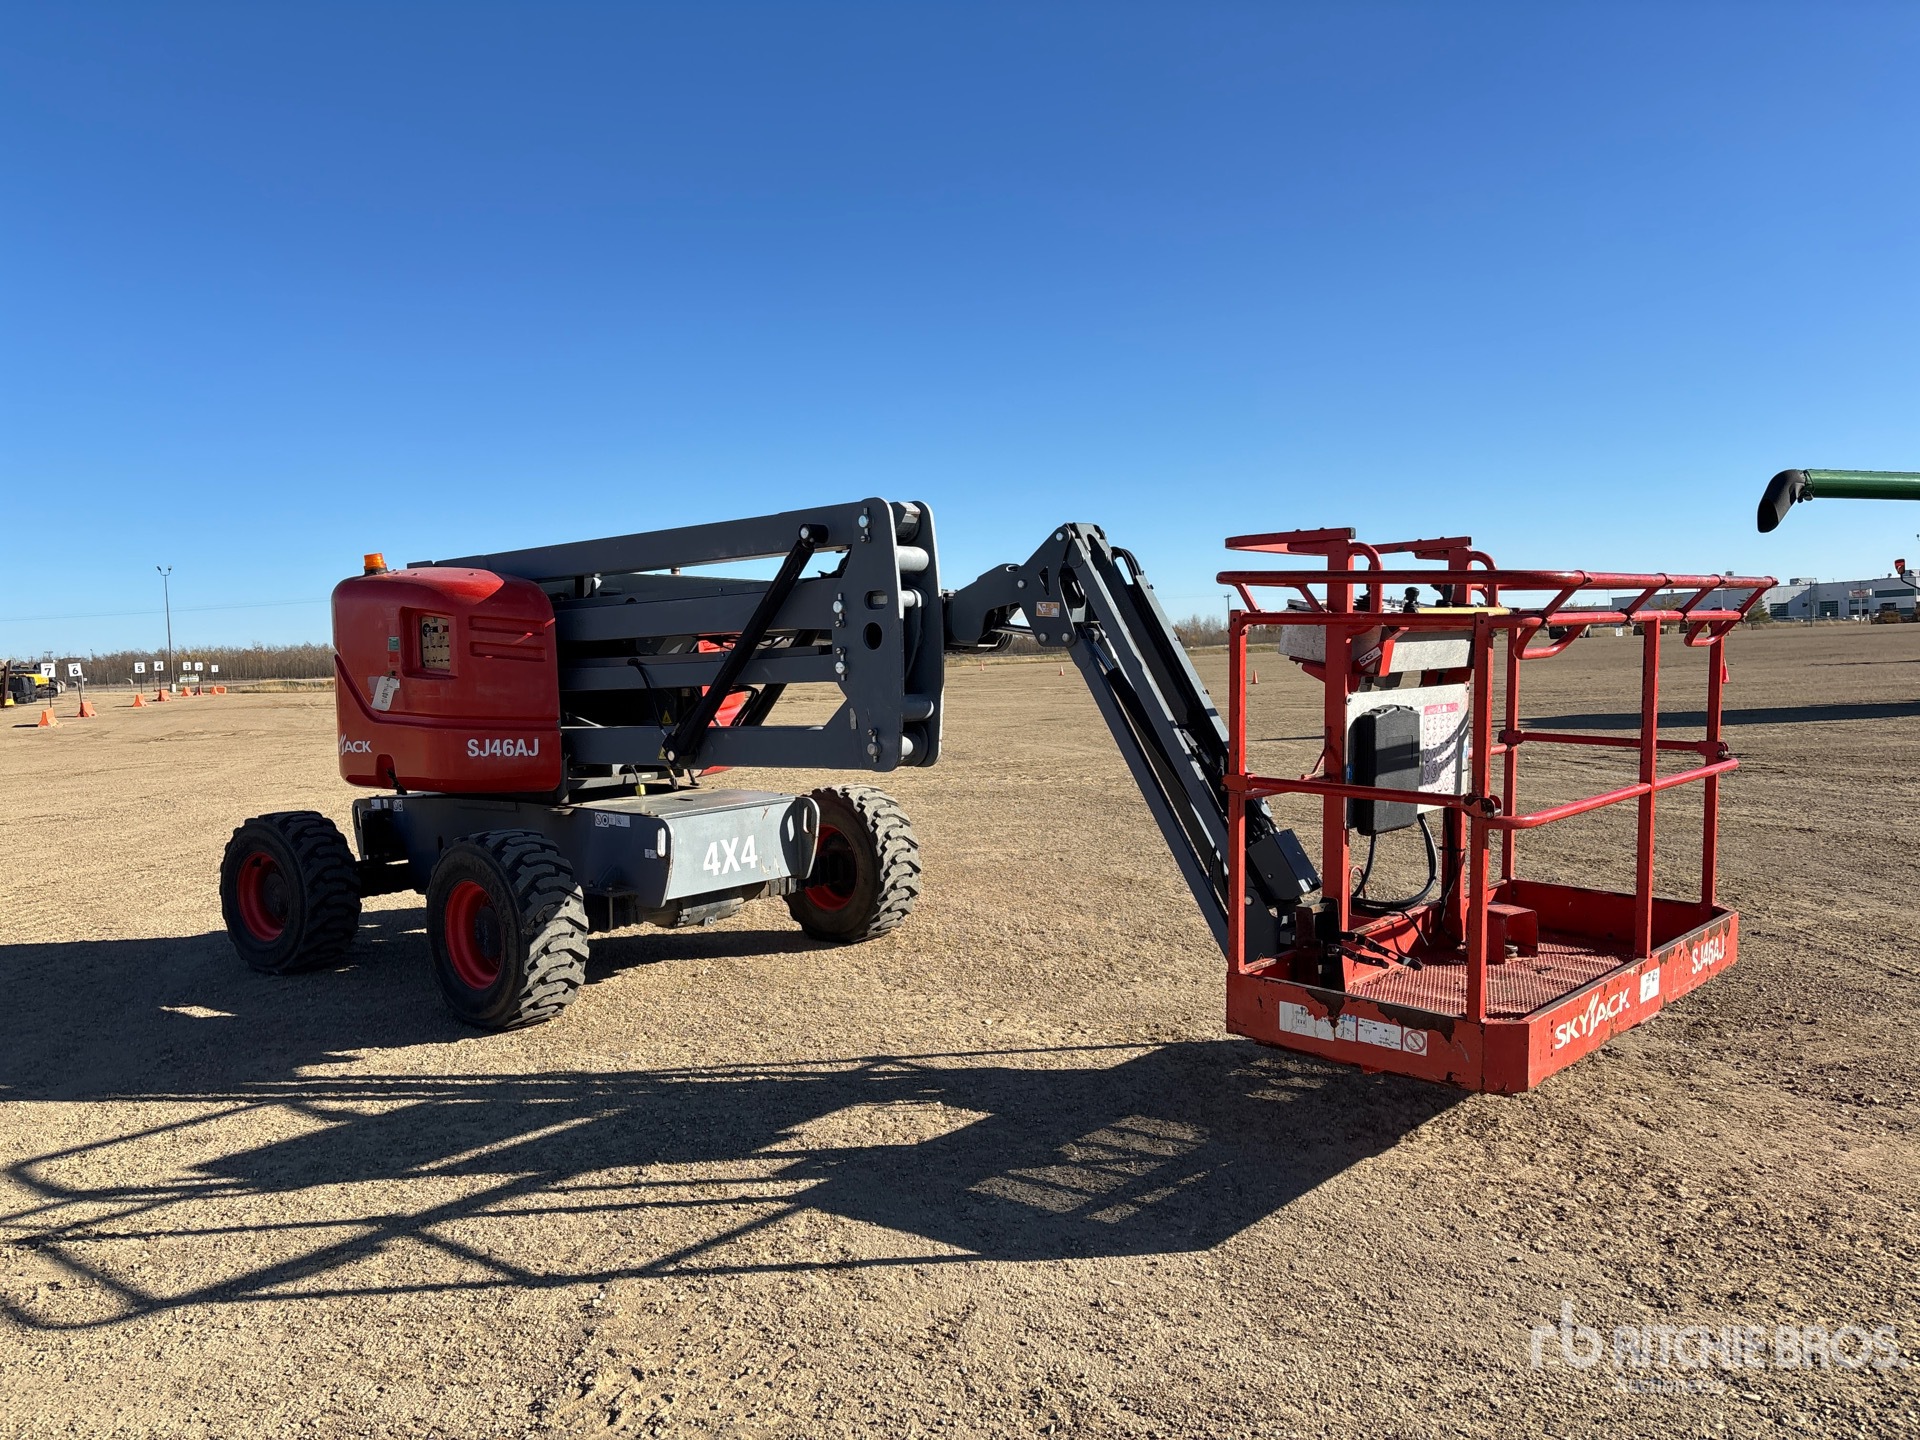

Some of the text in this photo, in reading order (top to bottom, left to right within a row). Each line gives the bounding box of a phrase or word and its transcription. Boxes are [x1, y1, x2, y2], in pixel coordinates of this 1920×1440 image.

[44, 668, 52, 676] 7
[467, 738, 540, 757] SJ46AJ
[703, 834, 758, 876] 4X4
[1691, 934, 1726, 974] SJ46AJ
[1554, 987, 1630, 1050] SKYJACK
